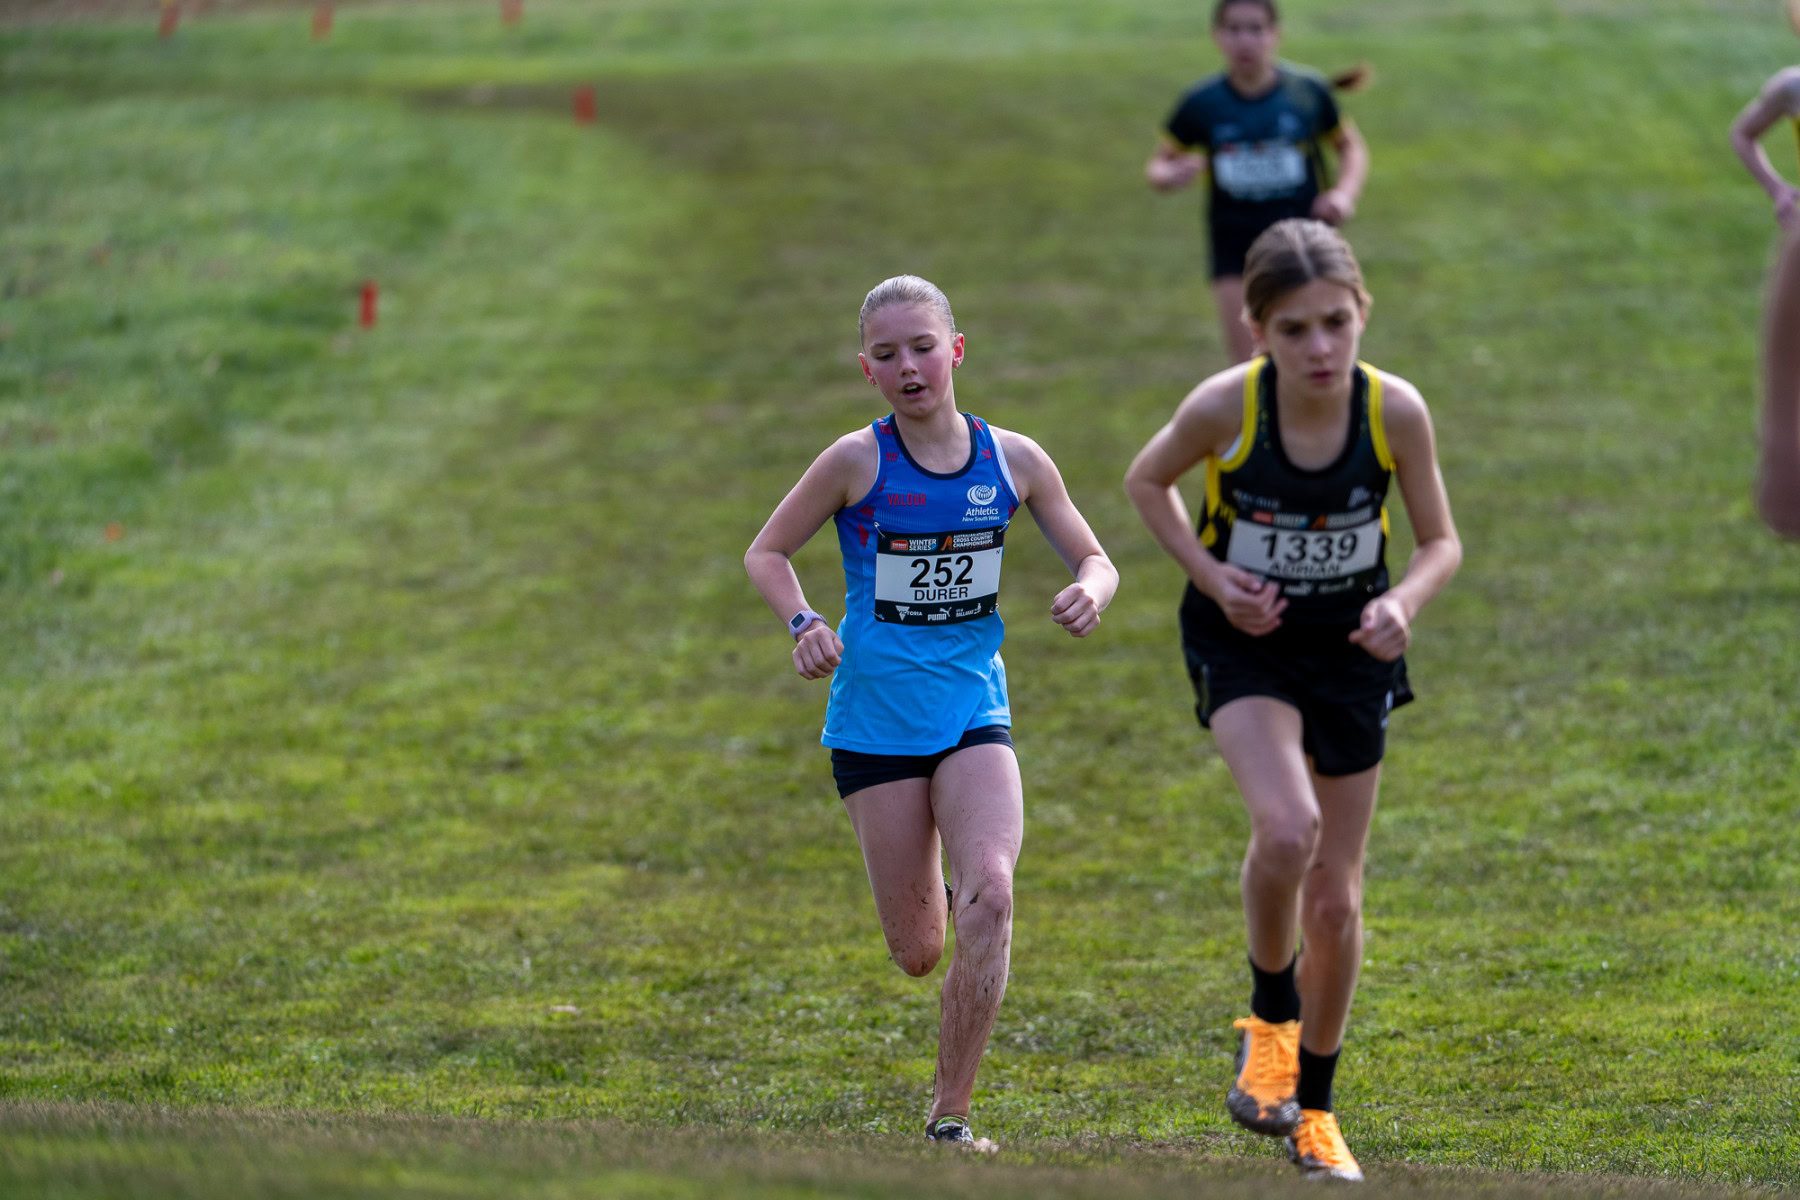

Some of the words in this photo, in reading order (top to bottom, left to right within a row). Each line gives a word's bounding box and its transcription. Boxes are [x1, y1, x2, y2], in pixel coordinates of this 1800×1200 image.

[887, 493, 926, 506] VALOUR
[965, 507, 999, 516] Athletics
[908, 538, 937, 546] WINTER
[952, 539, 993, 548] CHAMPIONSHIPS
[1260, 531, 1359, 563] 1339
[909, 555, 973, 588] 252
[1270, 562, 1342, 576] ADRIAN
[914, 587, 969, 601] DURER
[927, 613, 947, 621] PUMA
